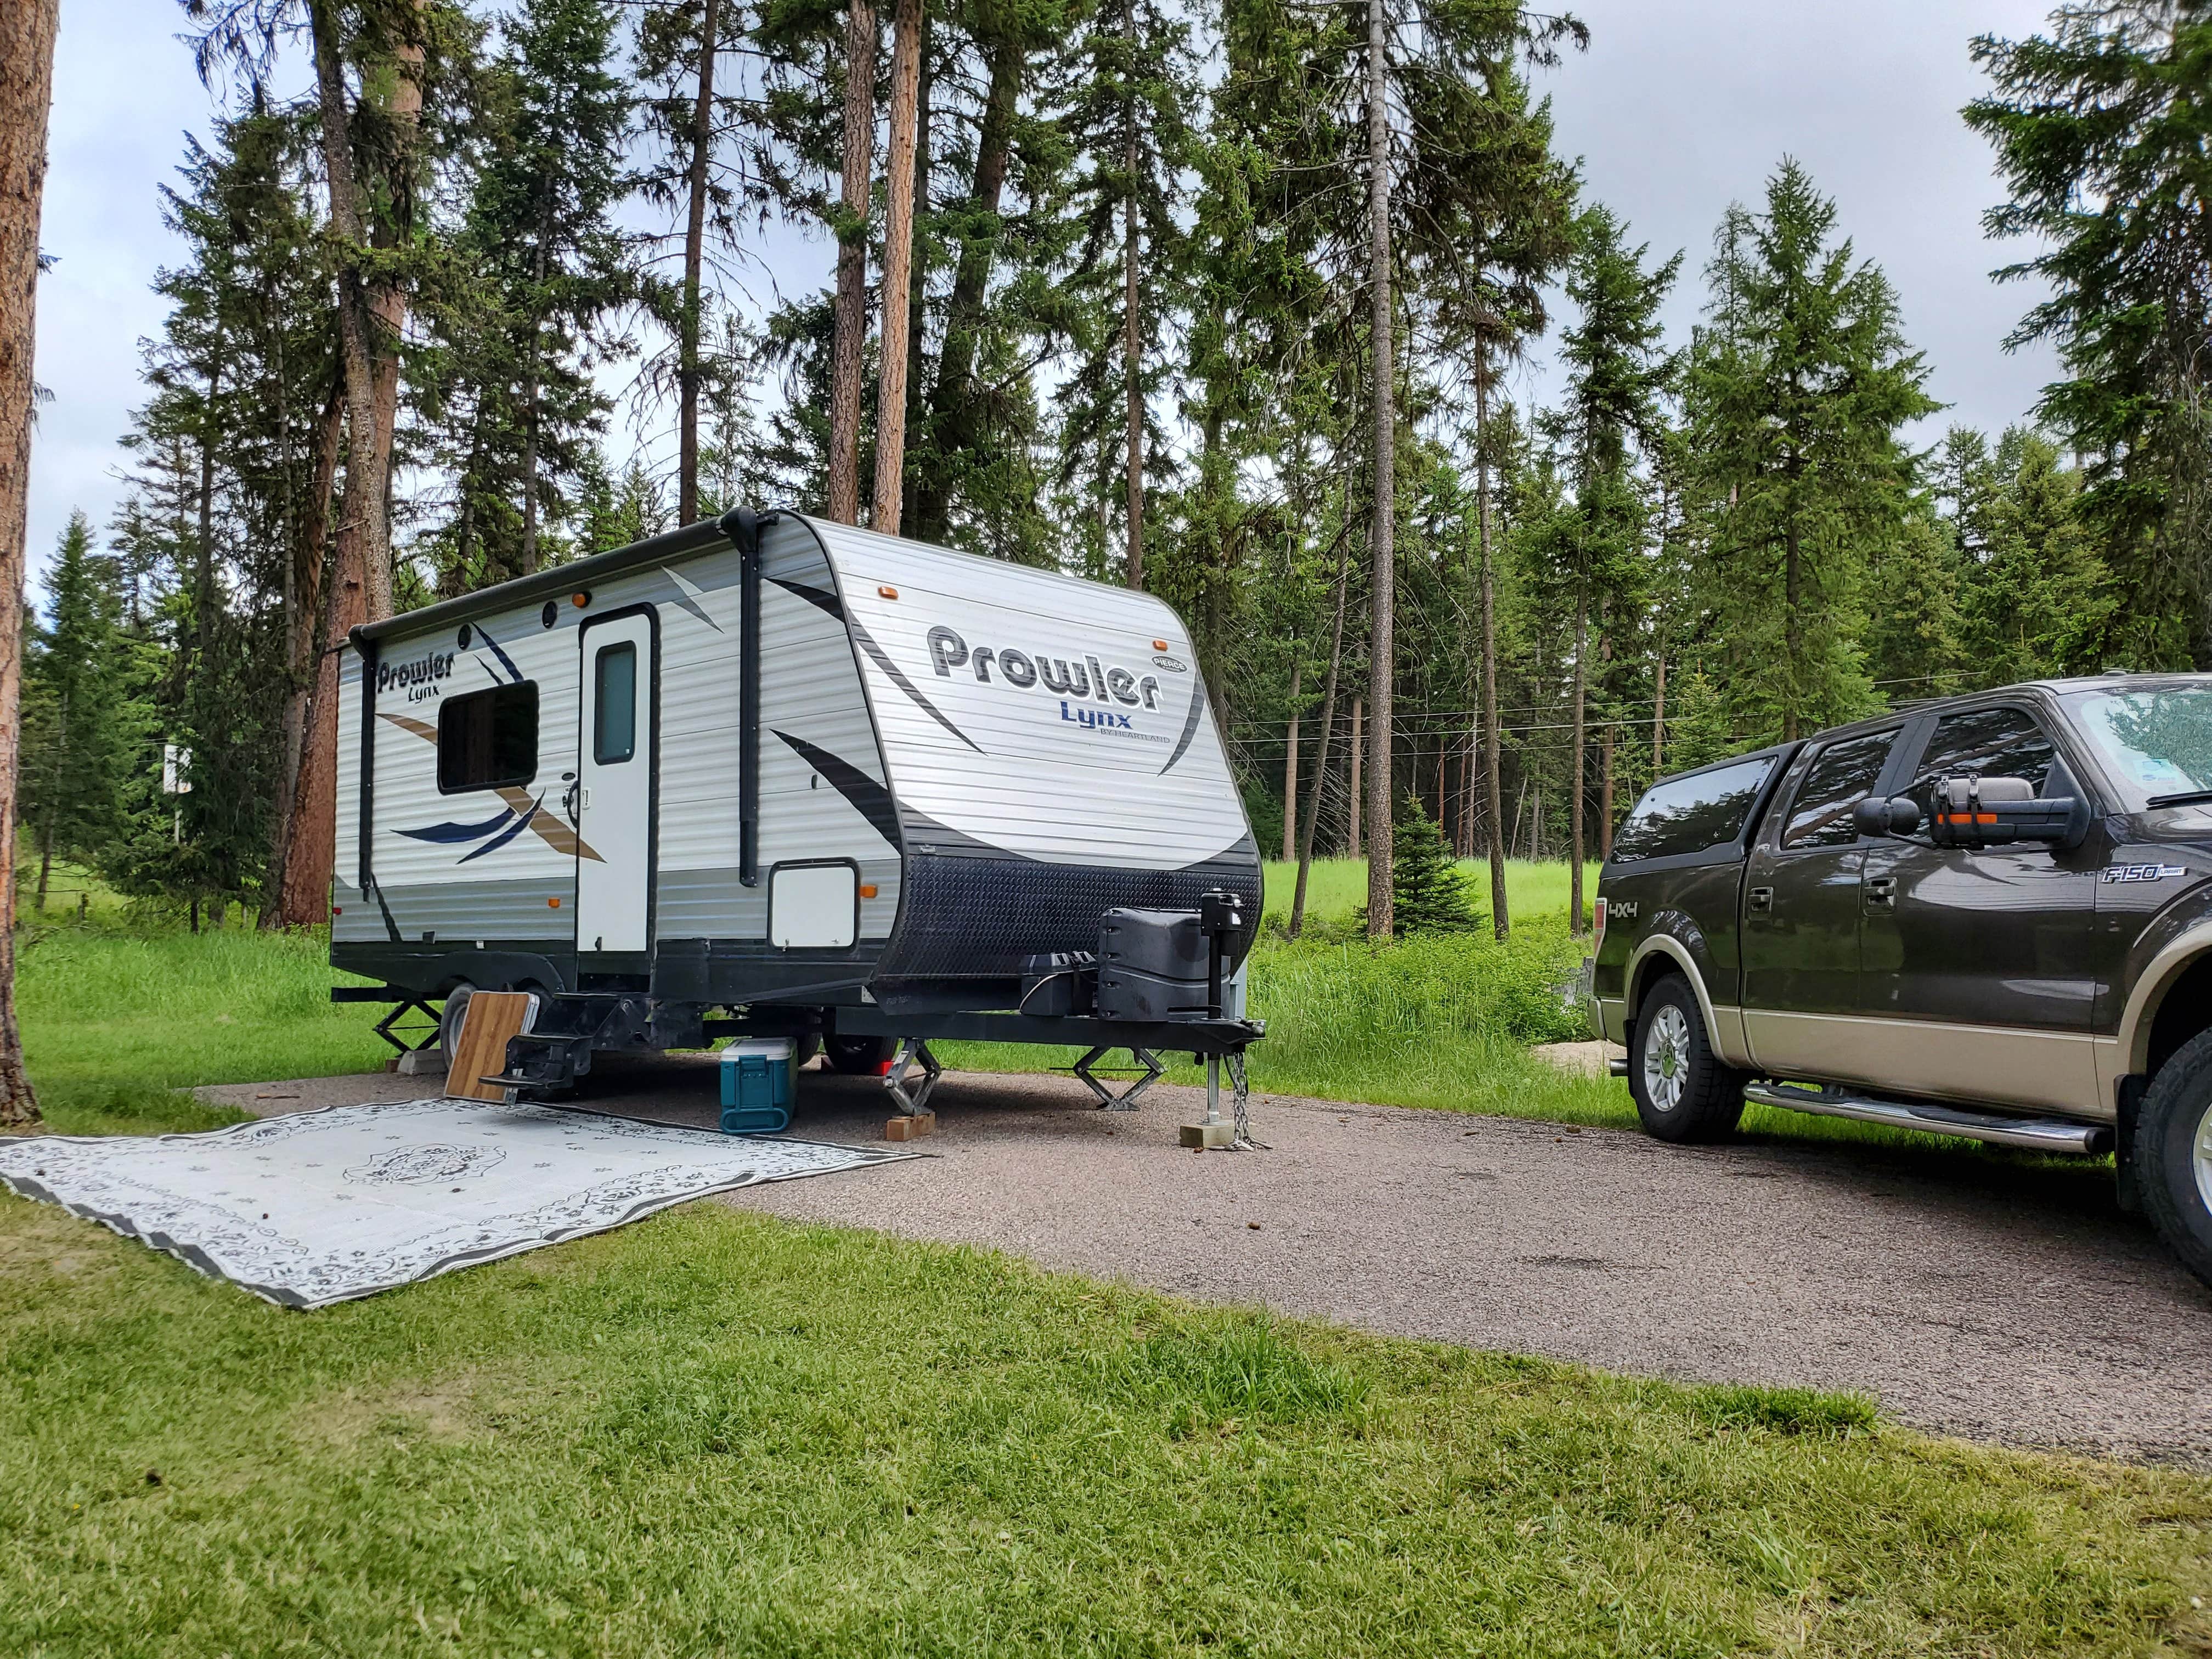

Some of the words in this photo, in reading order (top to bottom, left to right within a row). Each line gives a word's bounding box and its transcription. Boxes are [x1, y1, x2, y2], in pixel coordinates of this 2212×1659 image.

[377, 652, 455, 694] Prowler
[927, 626, 1164, 710] Prowler
[1153, 658, 1186, 670] PIERCE
[408, 684, 440, 704] Lynx
[1060, 701, 1133, 729] Lynx
[1115, 730, 1170, 743] HEARTLAND
[2102, 865, 2163, 883] F-150
